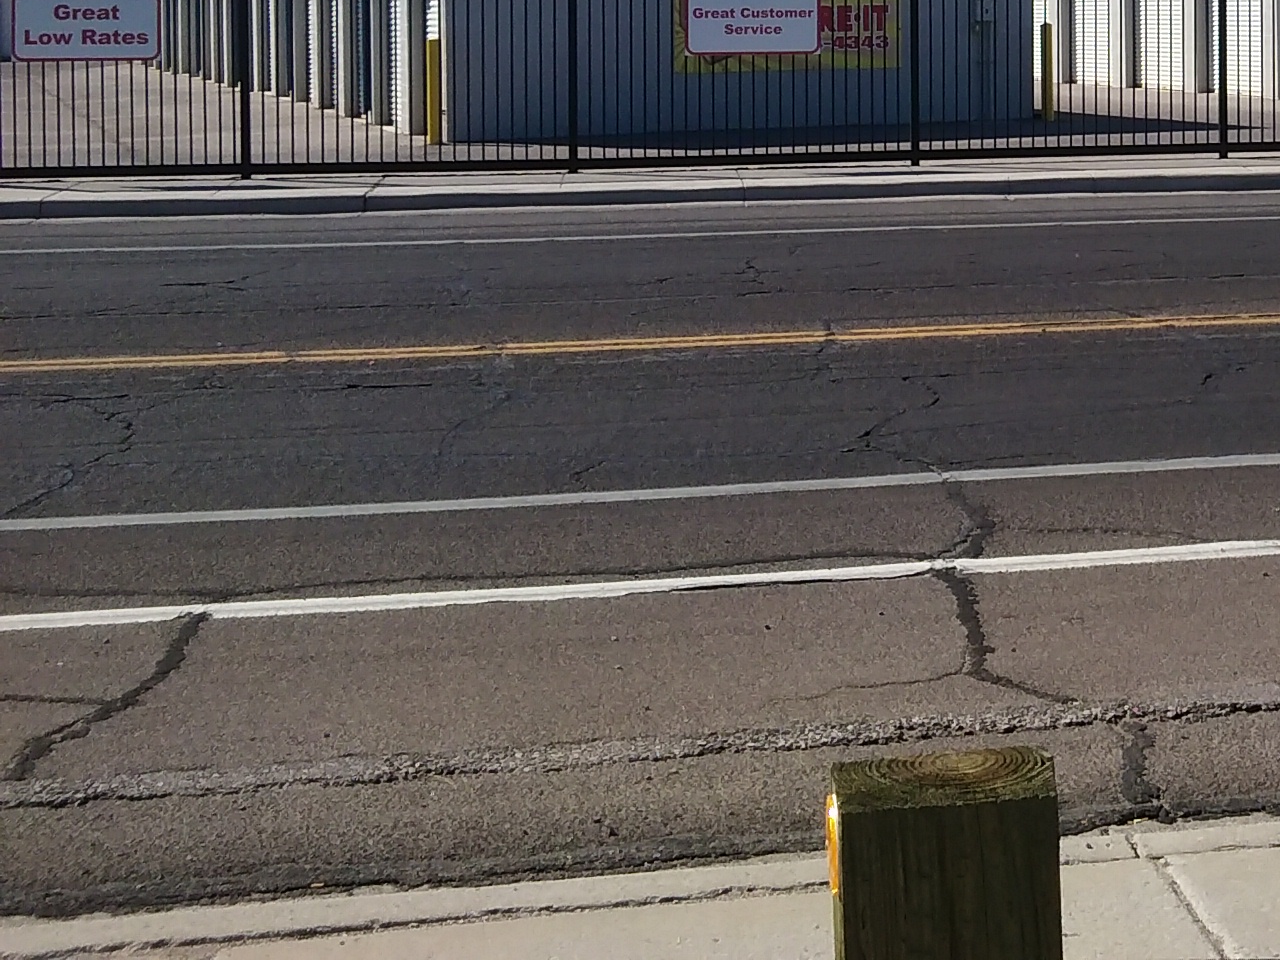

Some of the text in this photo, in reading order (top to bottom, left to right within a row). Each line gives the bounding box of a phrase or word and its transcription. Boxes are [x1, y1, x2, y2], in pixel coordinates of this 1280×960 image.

[53, 4, 120, 21] Great
[692, 7, 814, 19] Great Customer
[724, 23, 783, 35] Service
[24, 29, 149, 46] Low Rates
